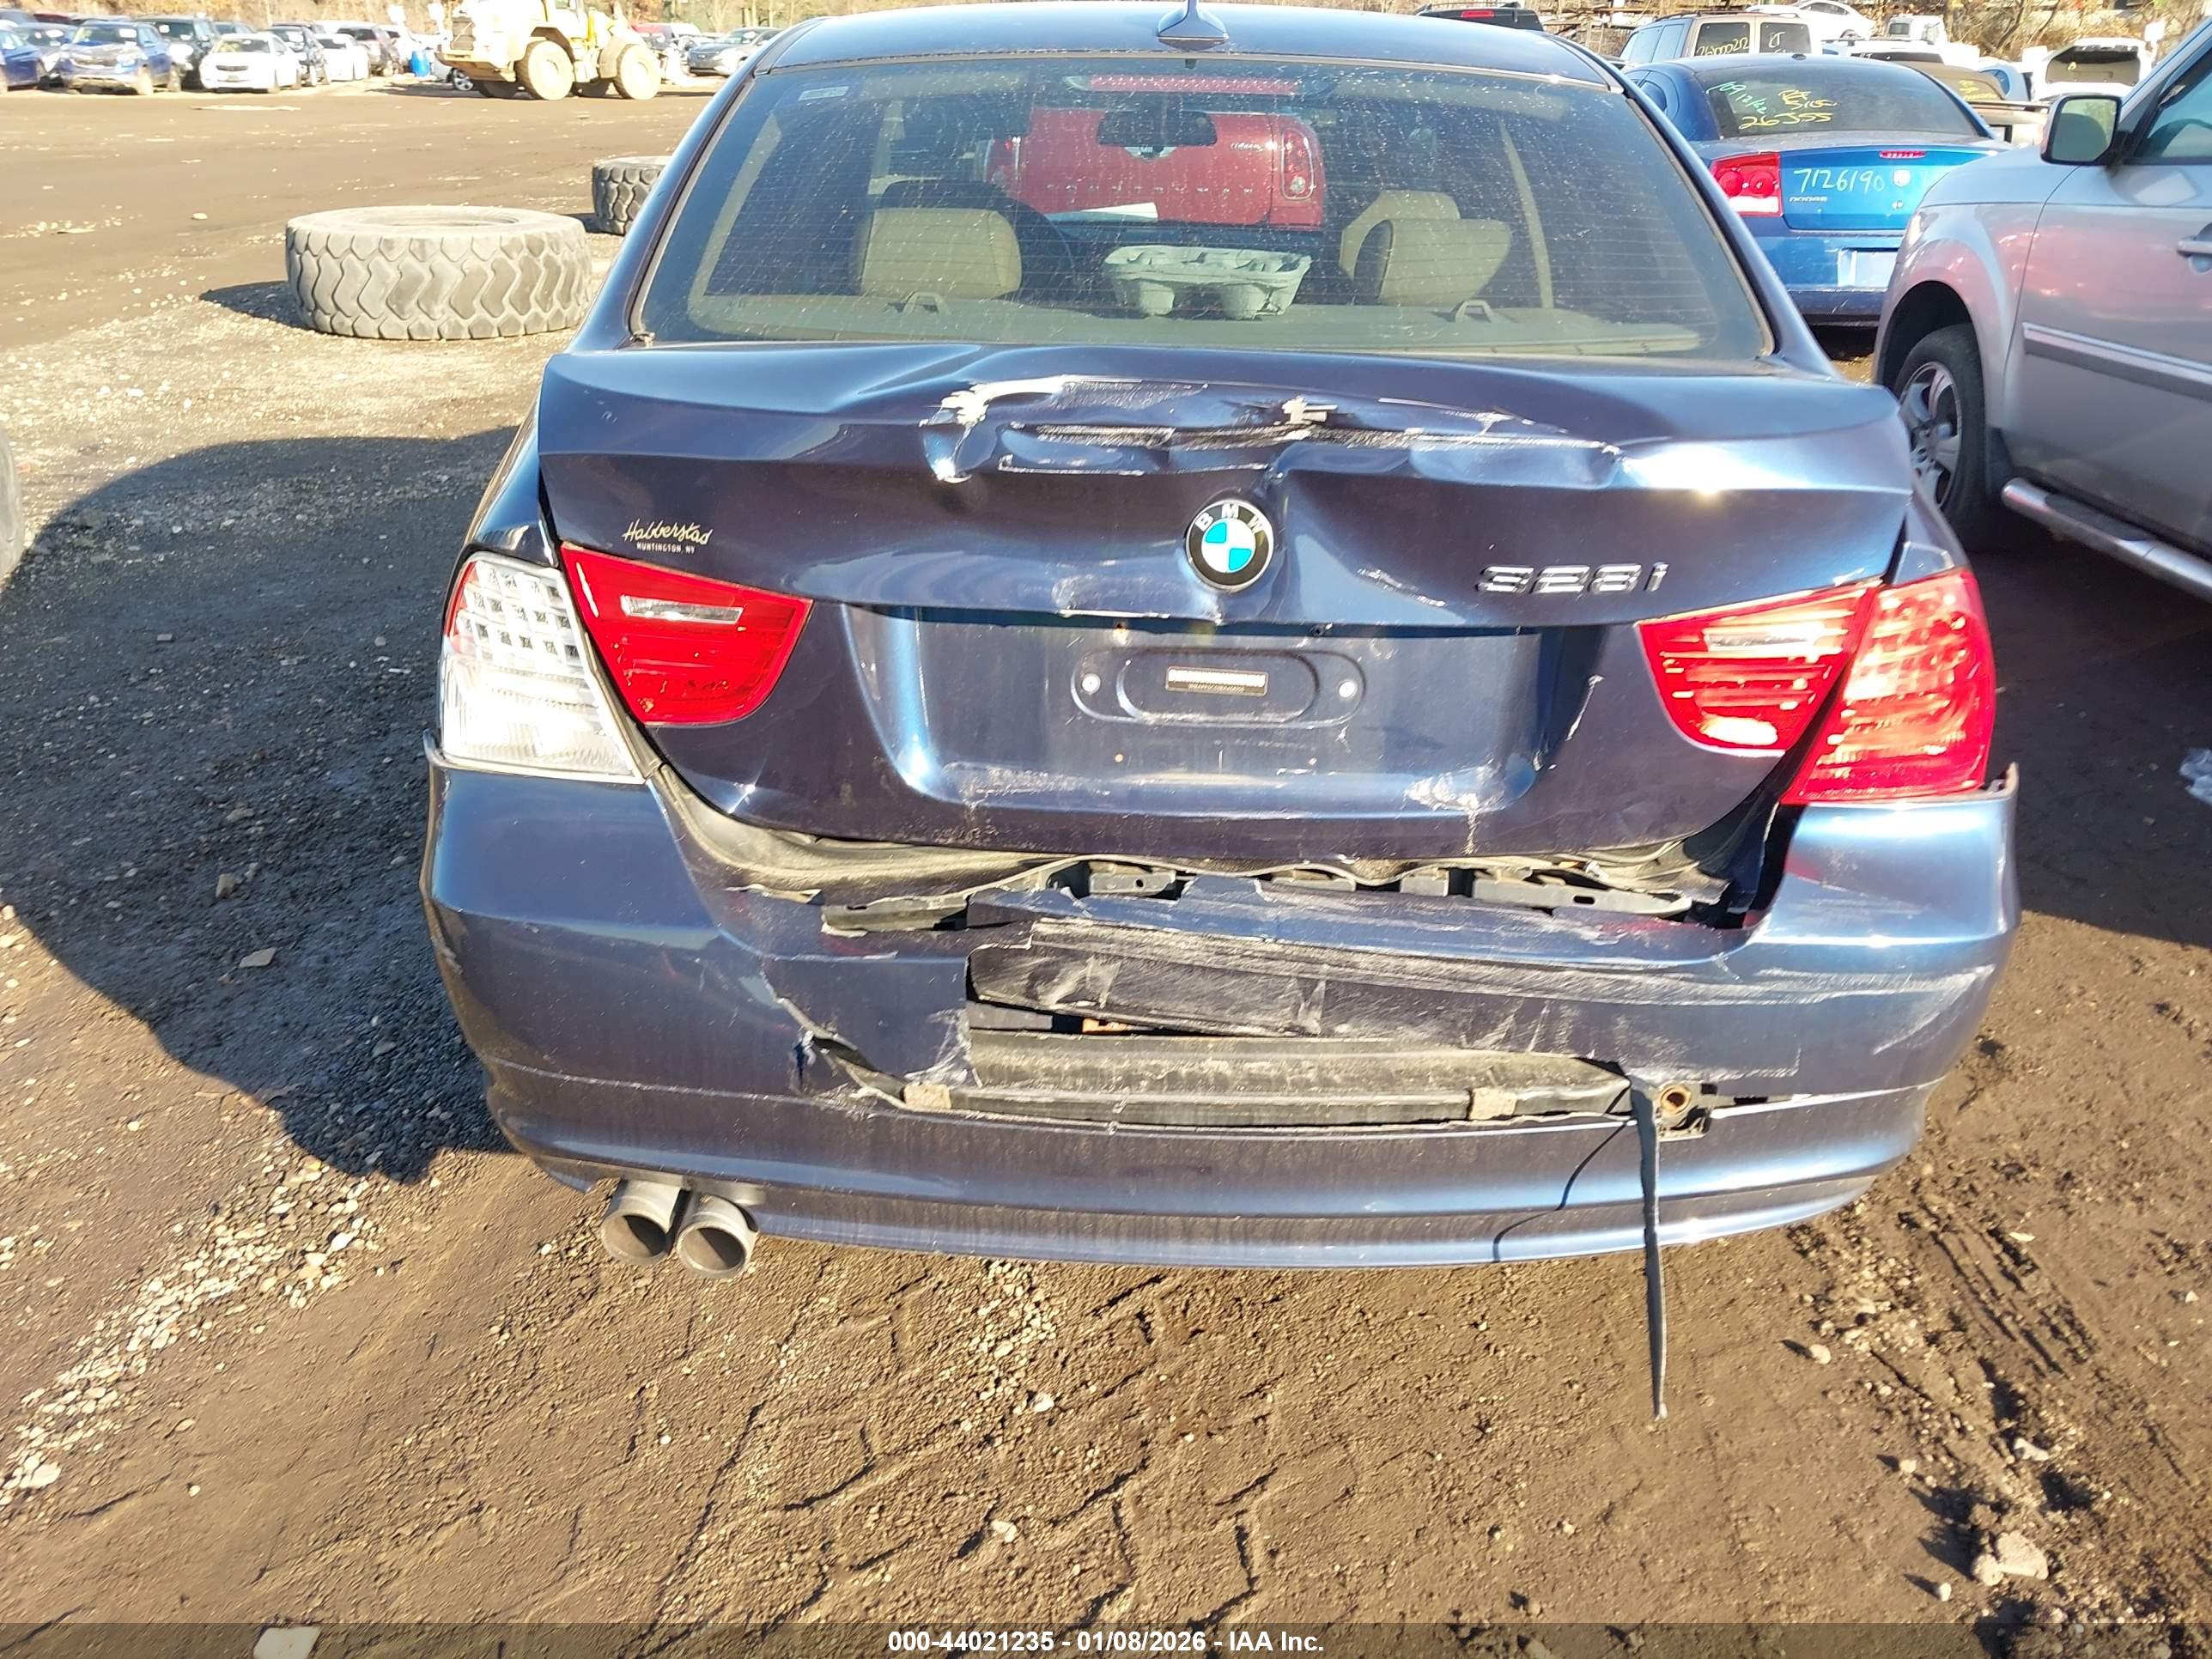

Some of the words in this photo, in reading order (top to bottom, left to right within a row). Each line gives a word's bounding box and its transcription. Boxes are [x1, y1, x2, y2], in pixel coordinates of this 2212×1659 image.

[1794, 167, 1886, 193] 7126190
[621, 518, 714, 545] Habberstad
[1194, 502, 1265, 535] BMW
[685, 545, 696, 555] NY
[1474, 562, 1669, 594] 328i
